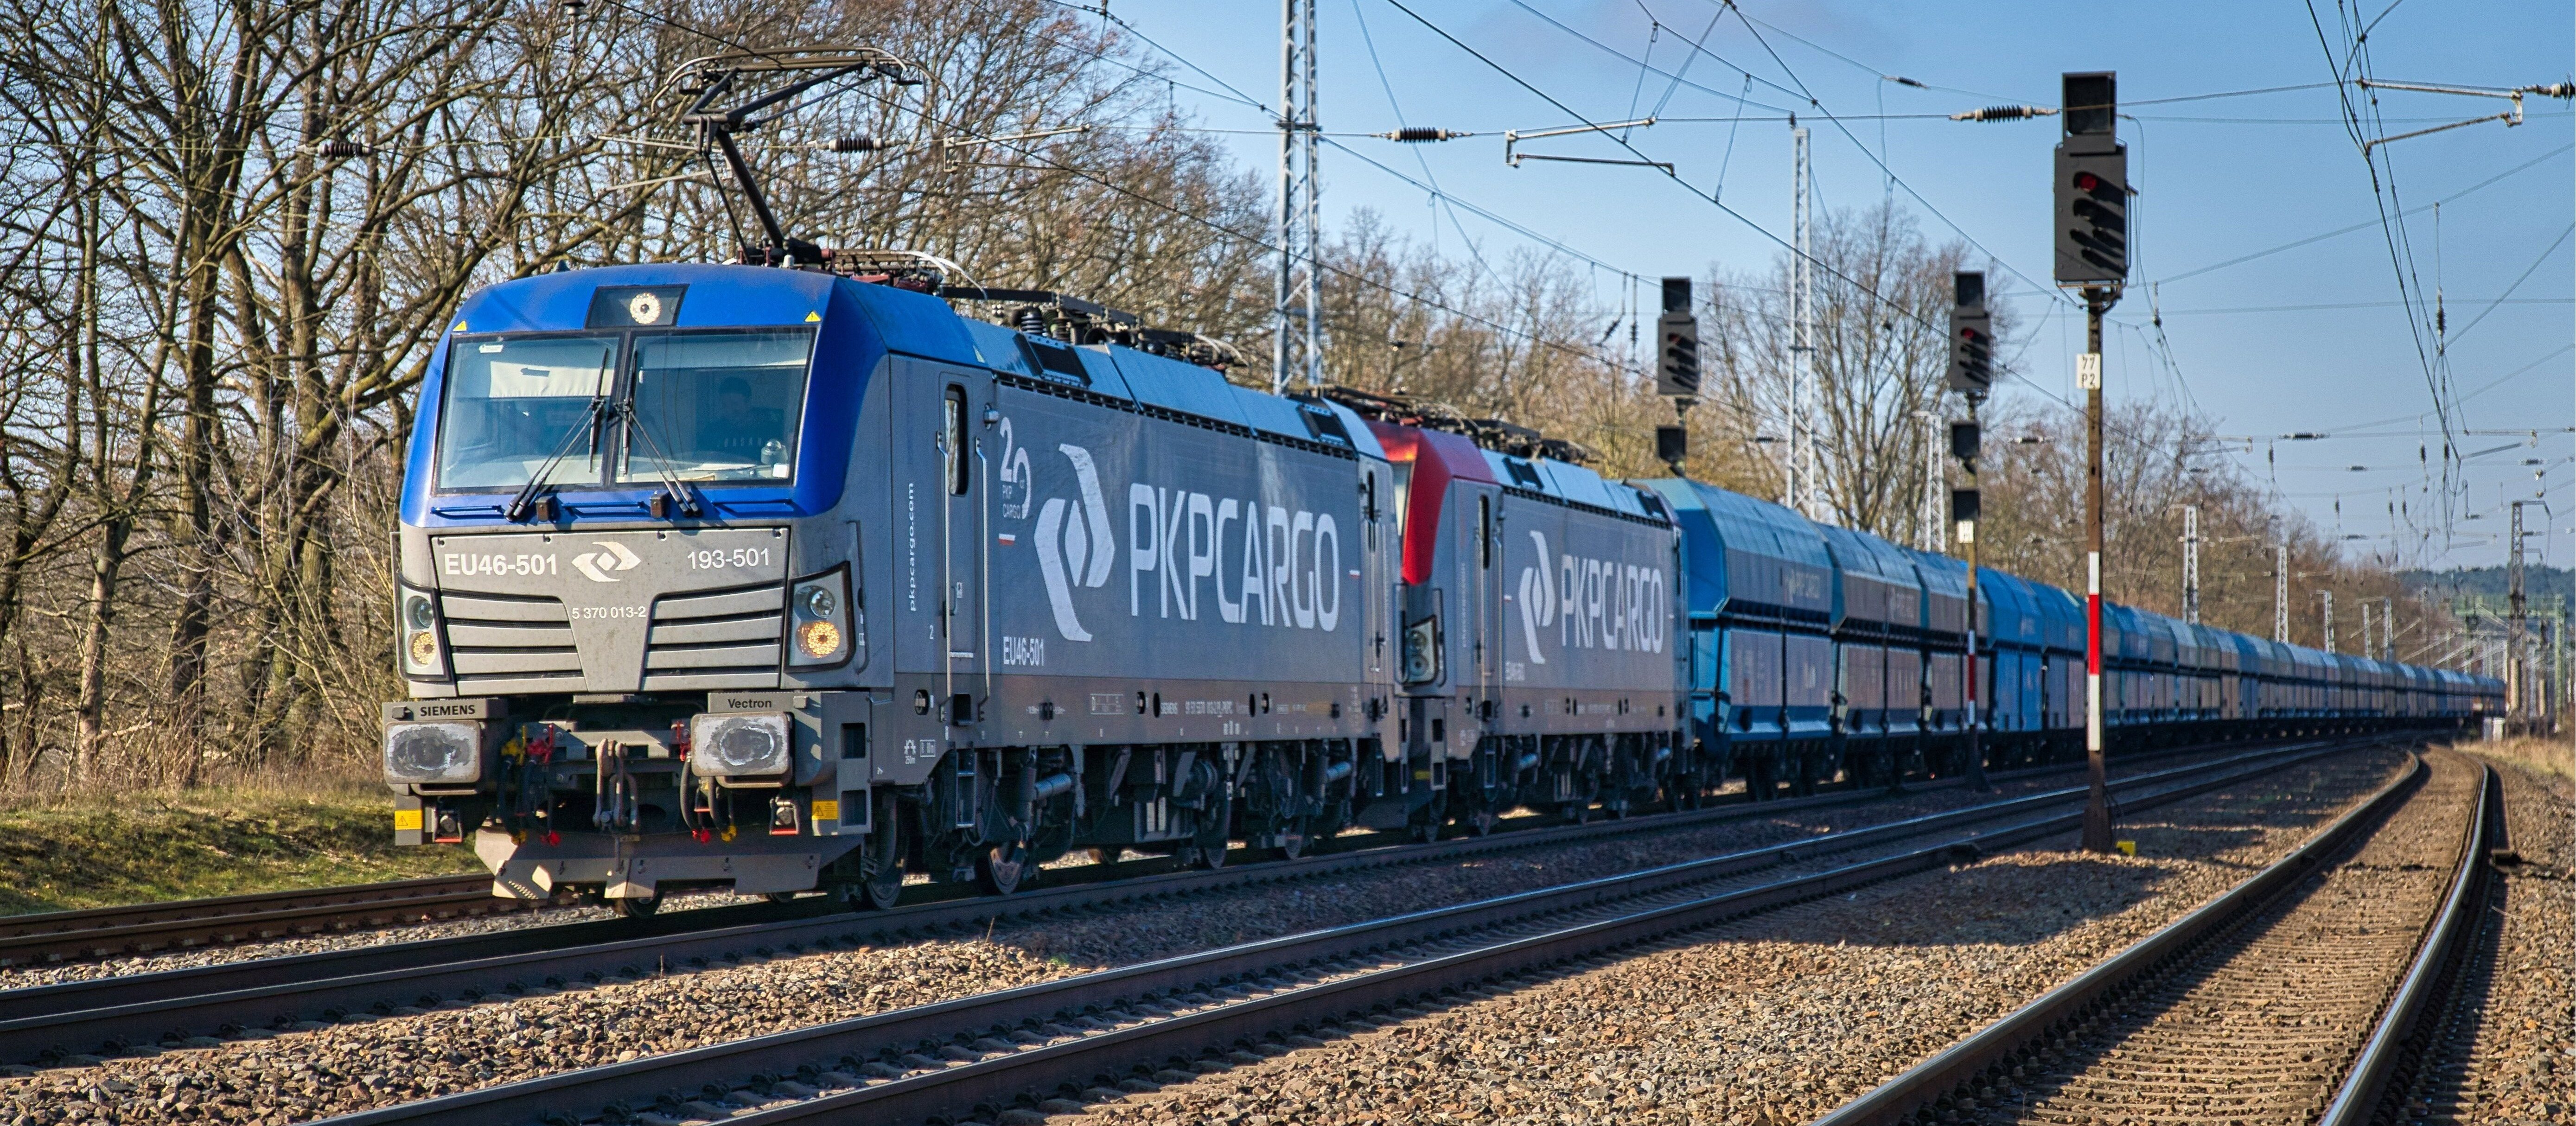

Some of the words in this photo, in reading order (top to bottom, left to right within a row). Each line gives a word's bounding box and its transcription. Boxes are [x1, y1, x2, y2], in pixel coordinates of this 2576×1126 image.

[2082, 356, 2095, 369] 77
[2082, 373, 2095, 385] P2
[1002, 484, 1012, 499] PKP
[1002, 503, 1020, 519] CARGO
[444, 553, 556, 575] EU46-501
[688, 548, 769, 569] 193-501
[1129, 483, 1339, 632] PKPCARGO
[1561, 554, 1664, 654] PKPCARGO
[572, 608, 580, 619] 5
[583, 607, 607, 619] 370
[612, 606, 646, 618] 013-2
[1003, 636, 1044, 666] EU46-501
[420, 705, 475, 717] SIEMENS
[727, 699, 772, 708] Vectron
